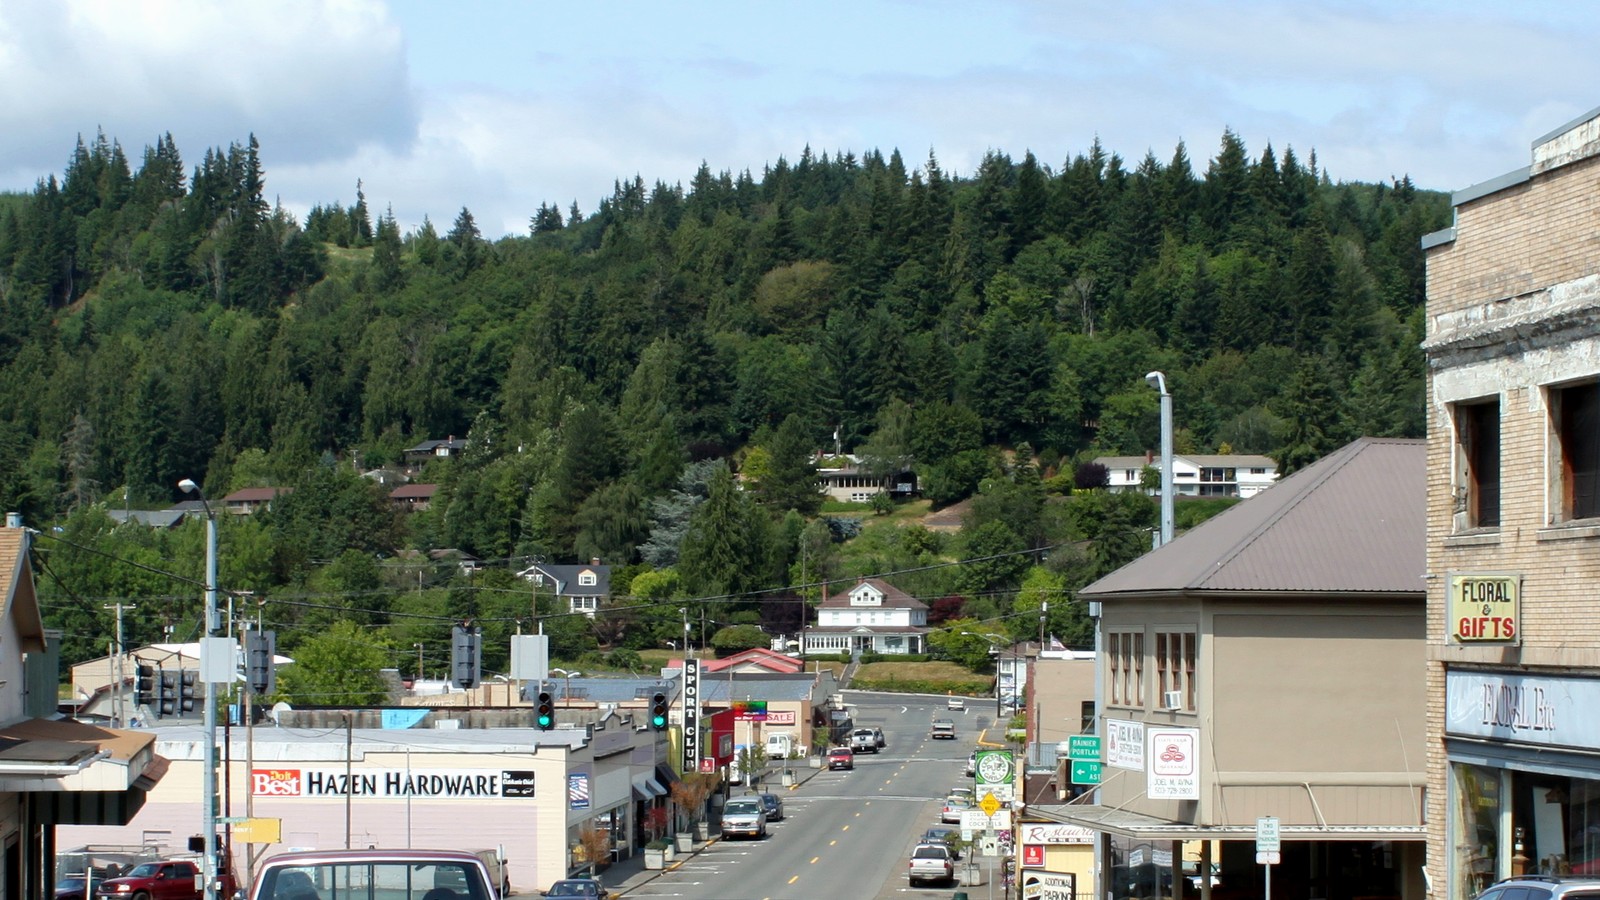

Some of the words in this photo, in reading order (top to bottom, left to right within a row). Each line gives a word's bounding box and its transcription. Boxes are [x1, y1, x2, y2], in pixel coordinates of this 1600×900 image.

[1462, 582, 1511, 602] FLORAL
[1482, 604, 1491, 616] &
[1459, 617, 1514, 638] GIFTS
[685, 664, 696, 718] SPORT
[767, 713, 793, 721] SALE
[1481, 684, 1531, 733] FLORAL
[1073, 748, 1099, 756] PORTLAN
[1089, 773, 1100, 781] AST
[1090, 764, 1098, 772] TO
[252, 773, 300, 795] Best
[307, 772, 376, 795] HAZEN
[385, 772, 499, 795] HARDWARE
[1028, 826, 1094, 842] Restaura
